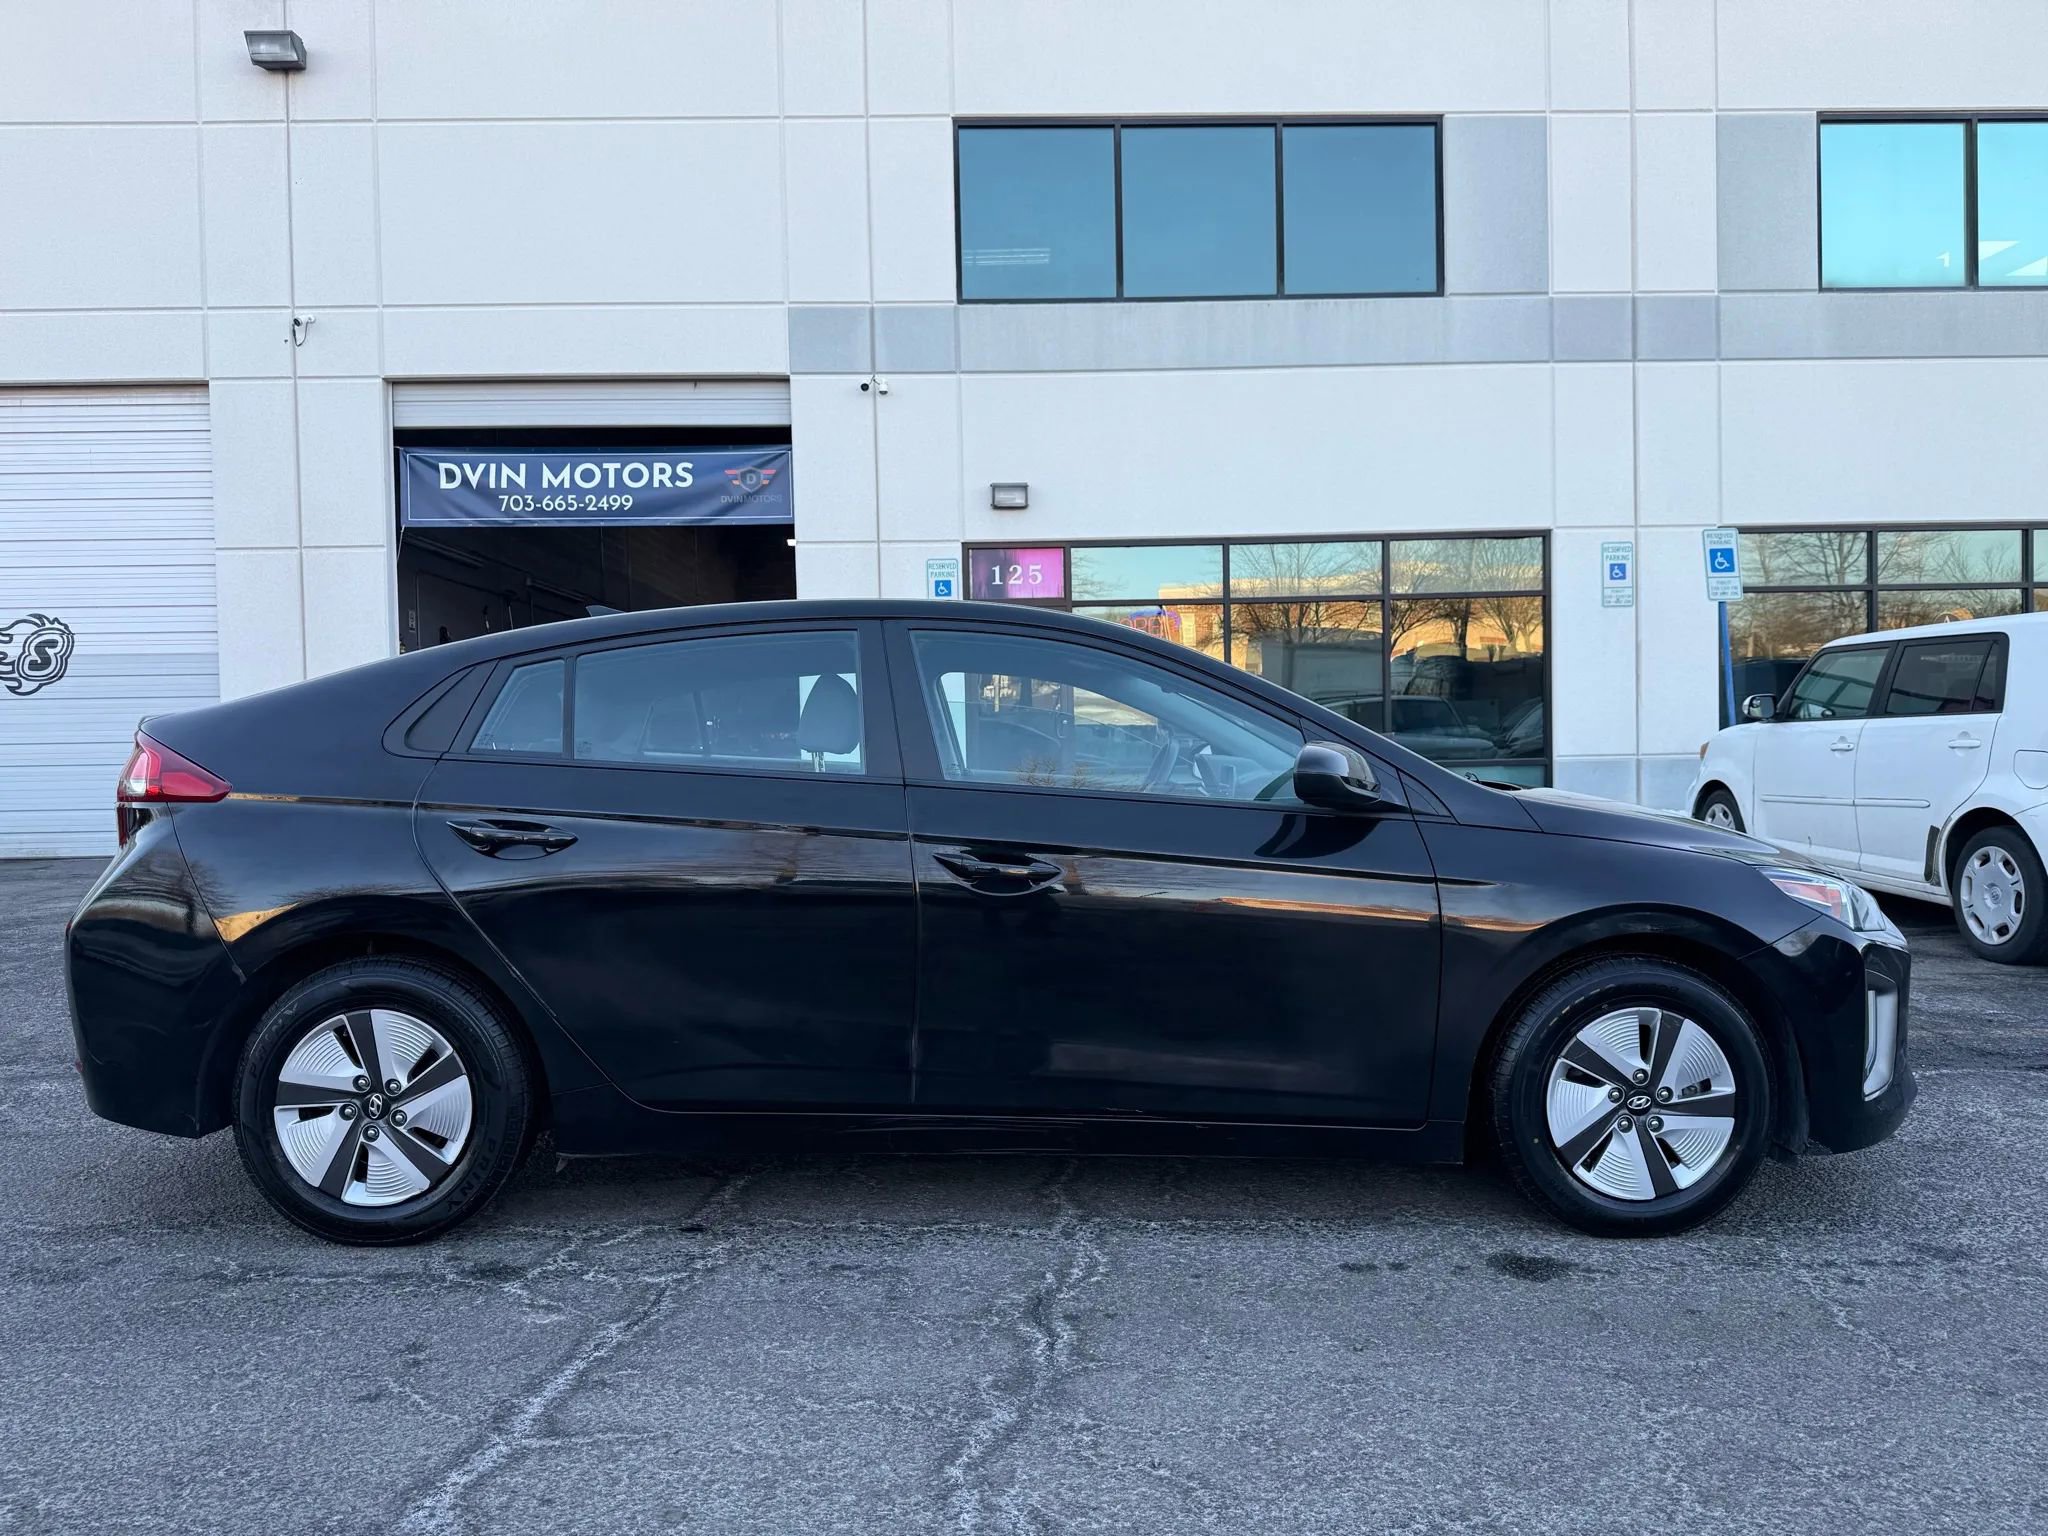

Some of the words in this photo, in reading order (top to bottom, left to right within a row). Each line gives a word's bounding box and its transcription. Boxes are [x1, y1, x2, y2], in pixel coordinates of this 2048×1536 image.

[438, 462, 526, 489] DVIN
[542, 462, 694, 489] MOTORS
[746, 473, 756, 484] D
[498, 494, 633, 512] 703-665-2499
[991, 564, 1043, 585] 125
